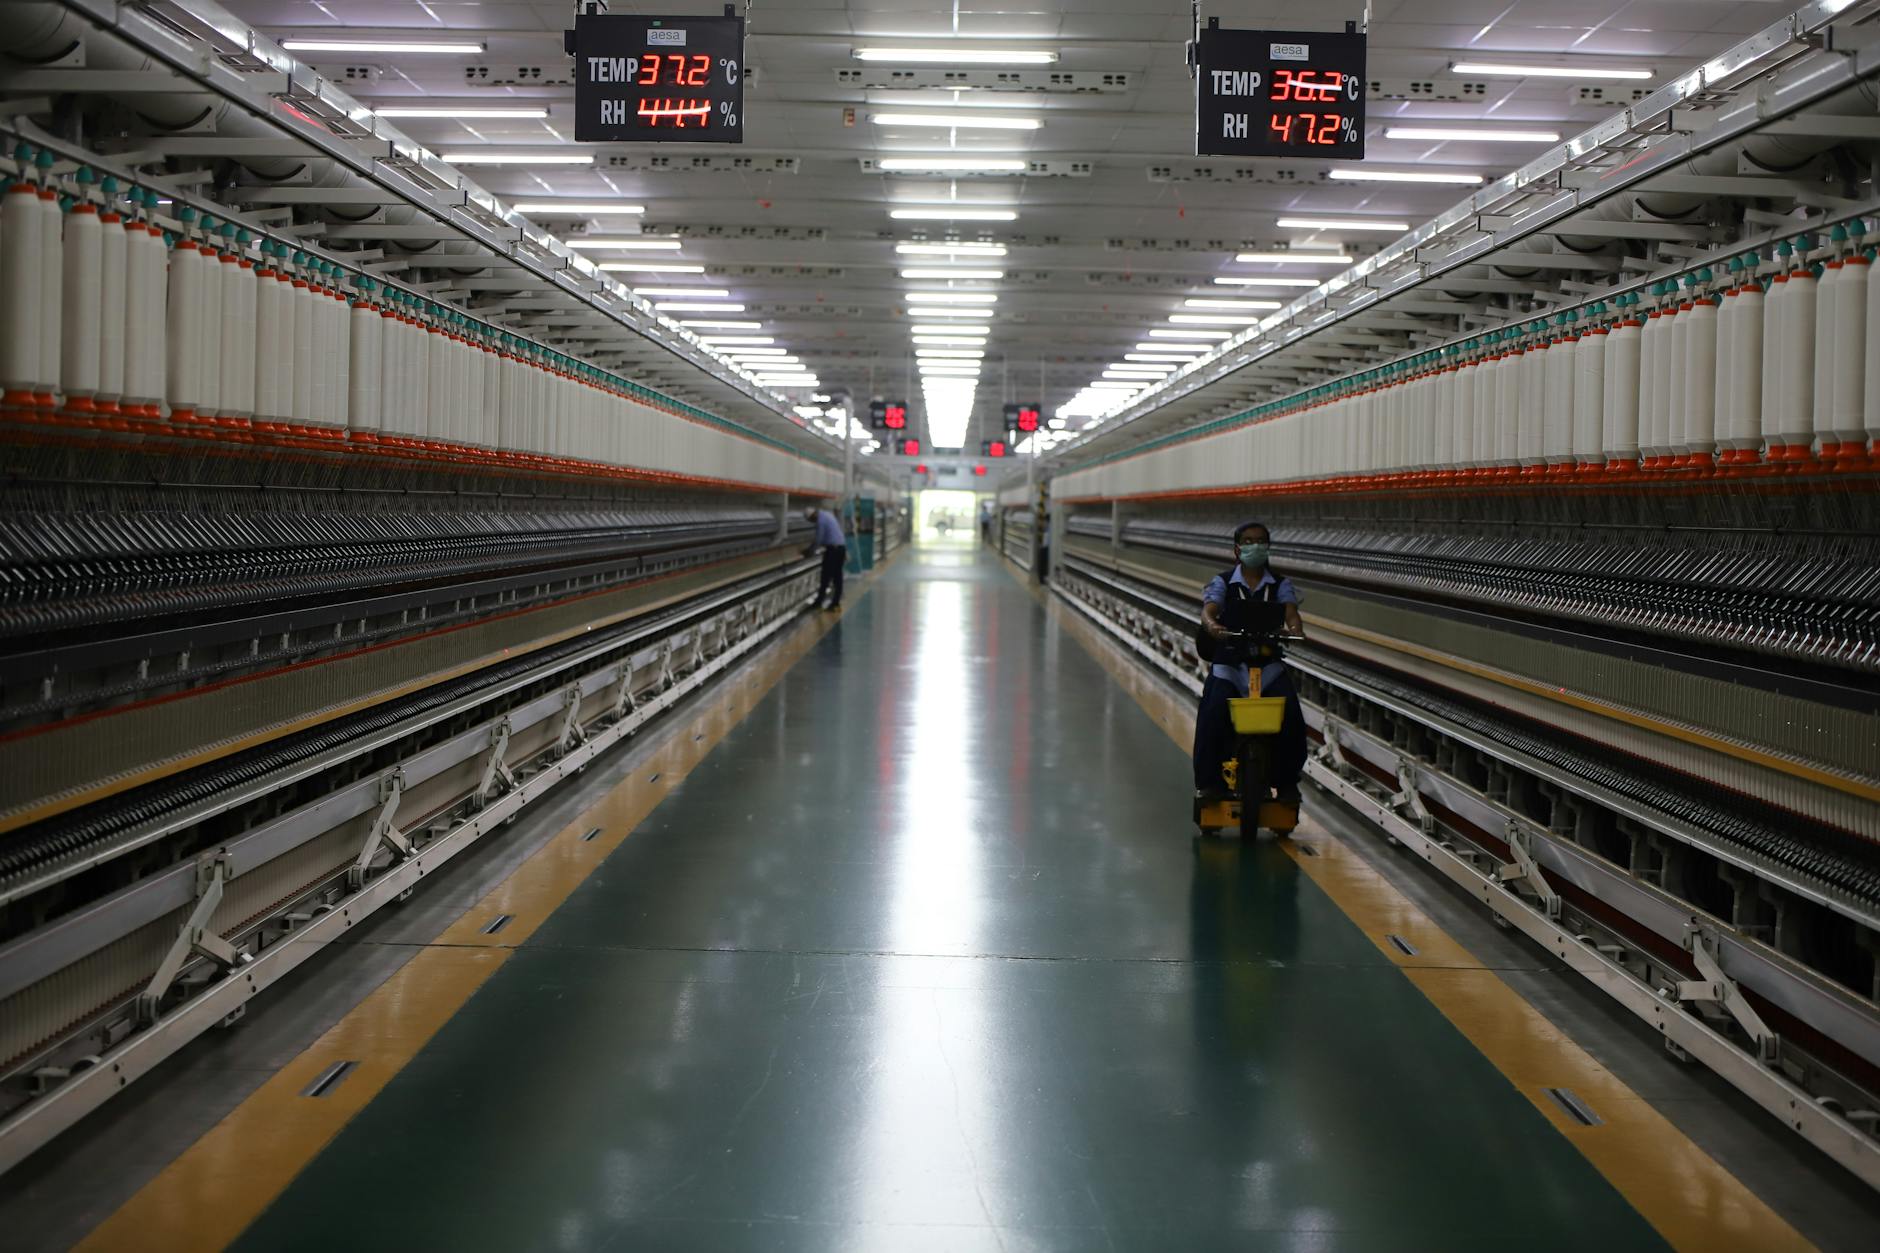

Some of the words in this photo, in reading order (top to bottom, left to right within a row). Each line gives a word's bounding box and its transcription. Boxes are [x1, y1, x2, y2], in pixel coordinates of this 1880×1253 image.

[651, 30, 680, 40] aesa
[1273, 45, 1302, 55] aesa
[588, 57, 638, 82] TEMP
[638, 55, 710, 85] 37.2
[719, 58, 737, 85] °C
[1211, 70, 1261, 96] TEMP
[1271, 70, 1342, 102] 36.2
[1341, 74, 1359, 101] °C
[600, 99, 625, 125] RH
[720, 101, 737, 127] %
[1223, 113, 1248, 138] RH
[1271, 113, 1341, 144] 47.2
[1342, 117, 1357, 143] %
